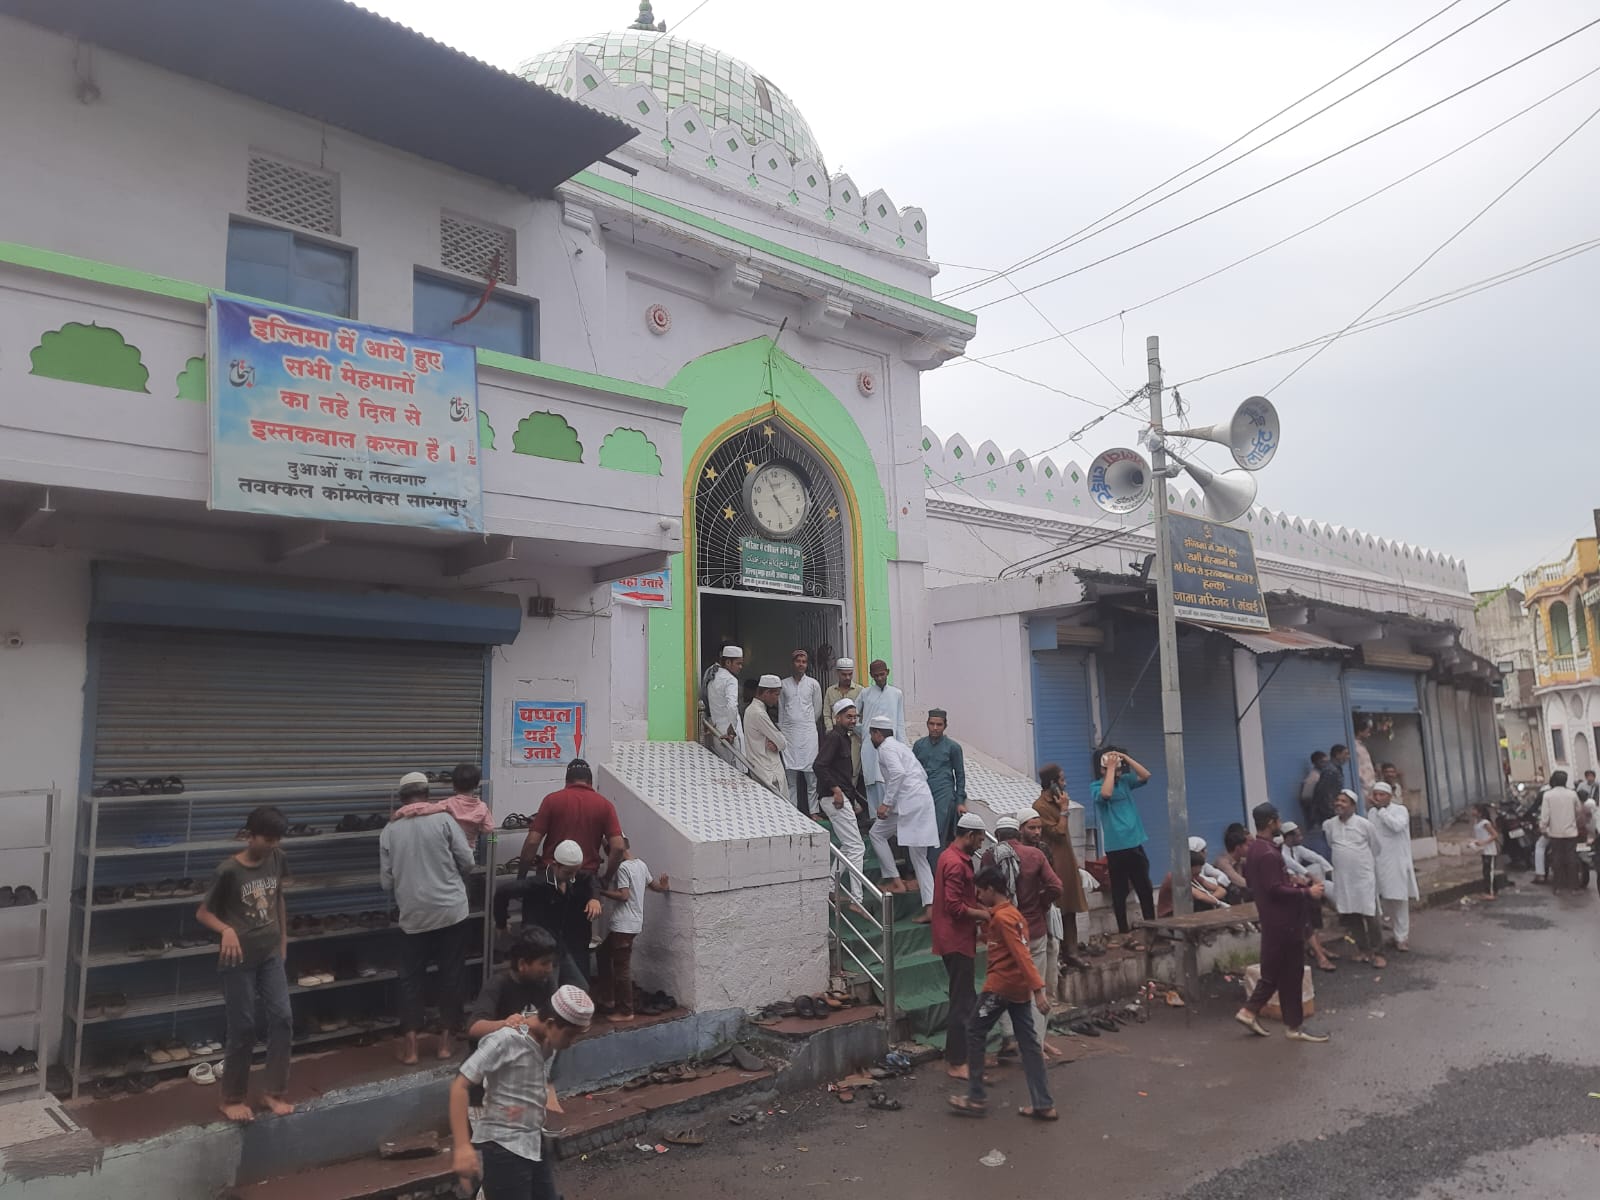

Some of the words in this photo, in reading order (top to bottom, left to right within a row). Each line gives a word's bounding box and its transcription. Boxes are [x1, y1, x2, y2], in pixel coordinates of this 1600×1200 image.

[251, 316, 330, 349] इज्तिमा
[337, 329, 356, 353] में
[366, 339, 406, 362] आये
[413, 349, 442, 373] हुए
[285, 357, 332, 382] सभी
[340, 362, 417, 394] मेहमानों
[280, 390, 310, 410] का
[318, 393, 350, 419] तहे
[358, 397, 397, 424] दिल
[404, 404, 422, 426] से
[250, 419, 357, 449] इस्तकबाल
[366, 434, 418, 457] करता
[425, 437, 440, 463] है
[288, 461, 338, 480] दुआओं
[344, 467, 363, 481] का
[238, 477, 315, 499] तवक्कल
[753, 486, 762, 494] 10
[640, 575, 664, 589] उतारे
[1173, 591, 1197, 605] जामा
[1198, 592, 1229, 608] मस्जिद
[519, 708, 572, 723] चप्पल
[523, 741, 562, 760] उतारे
